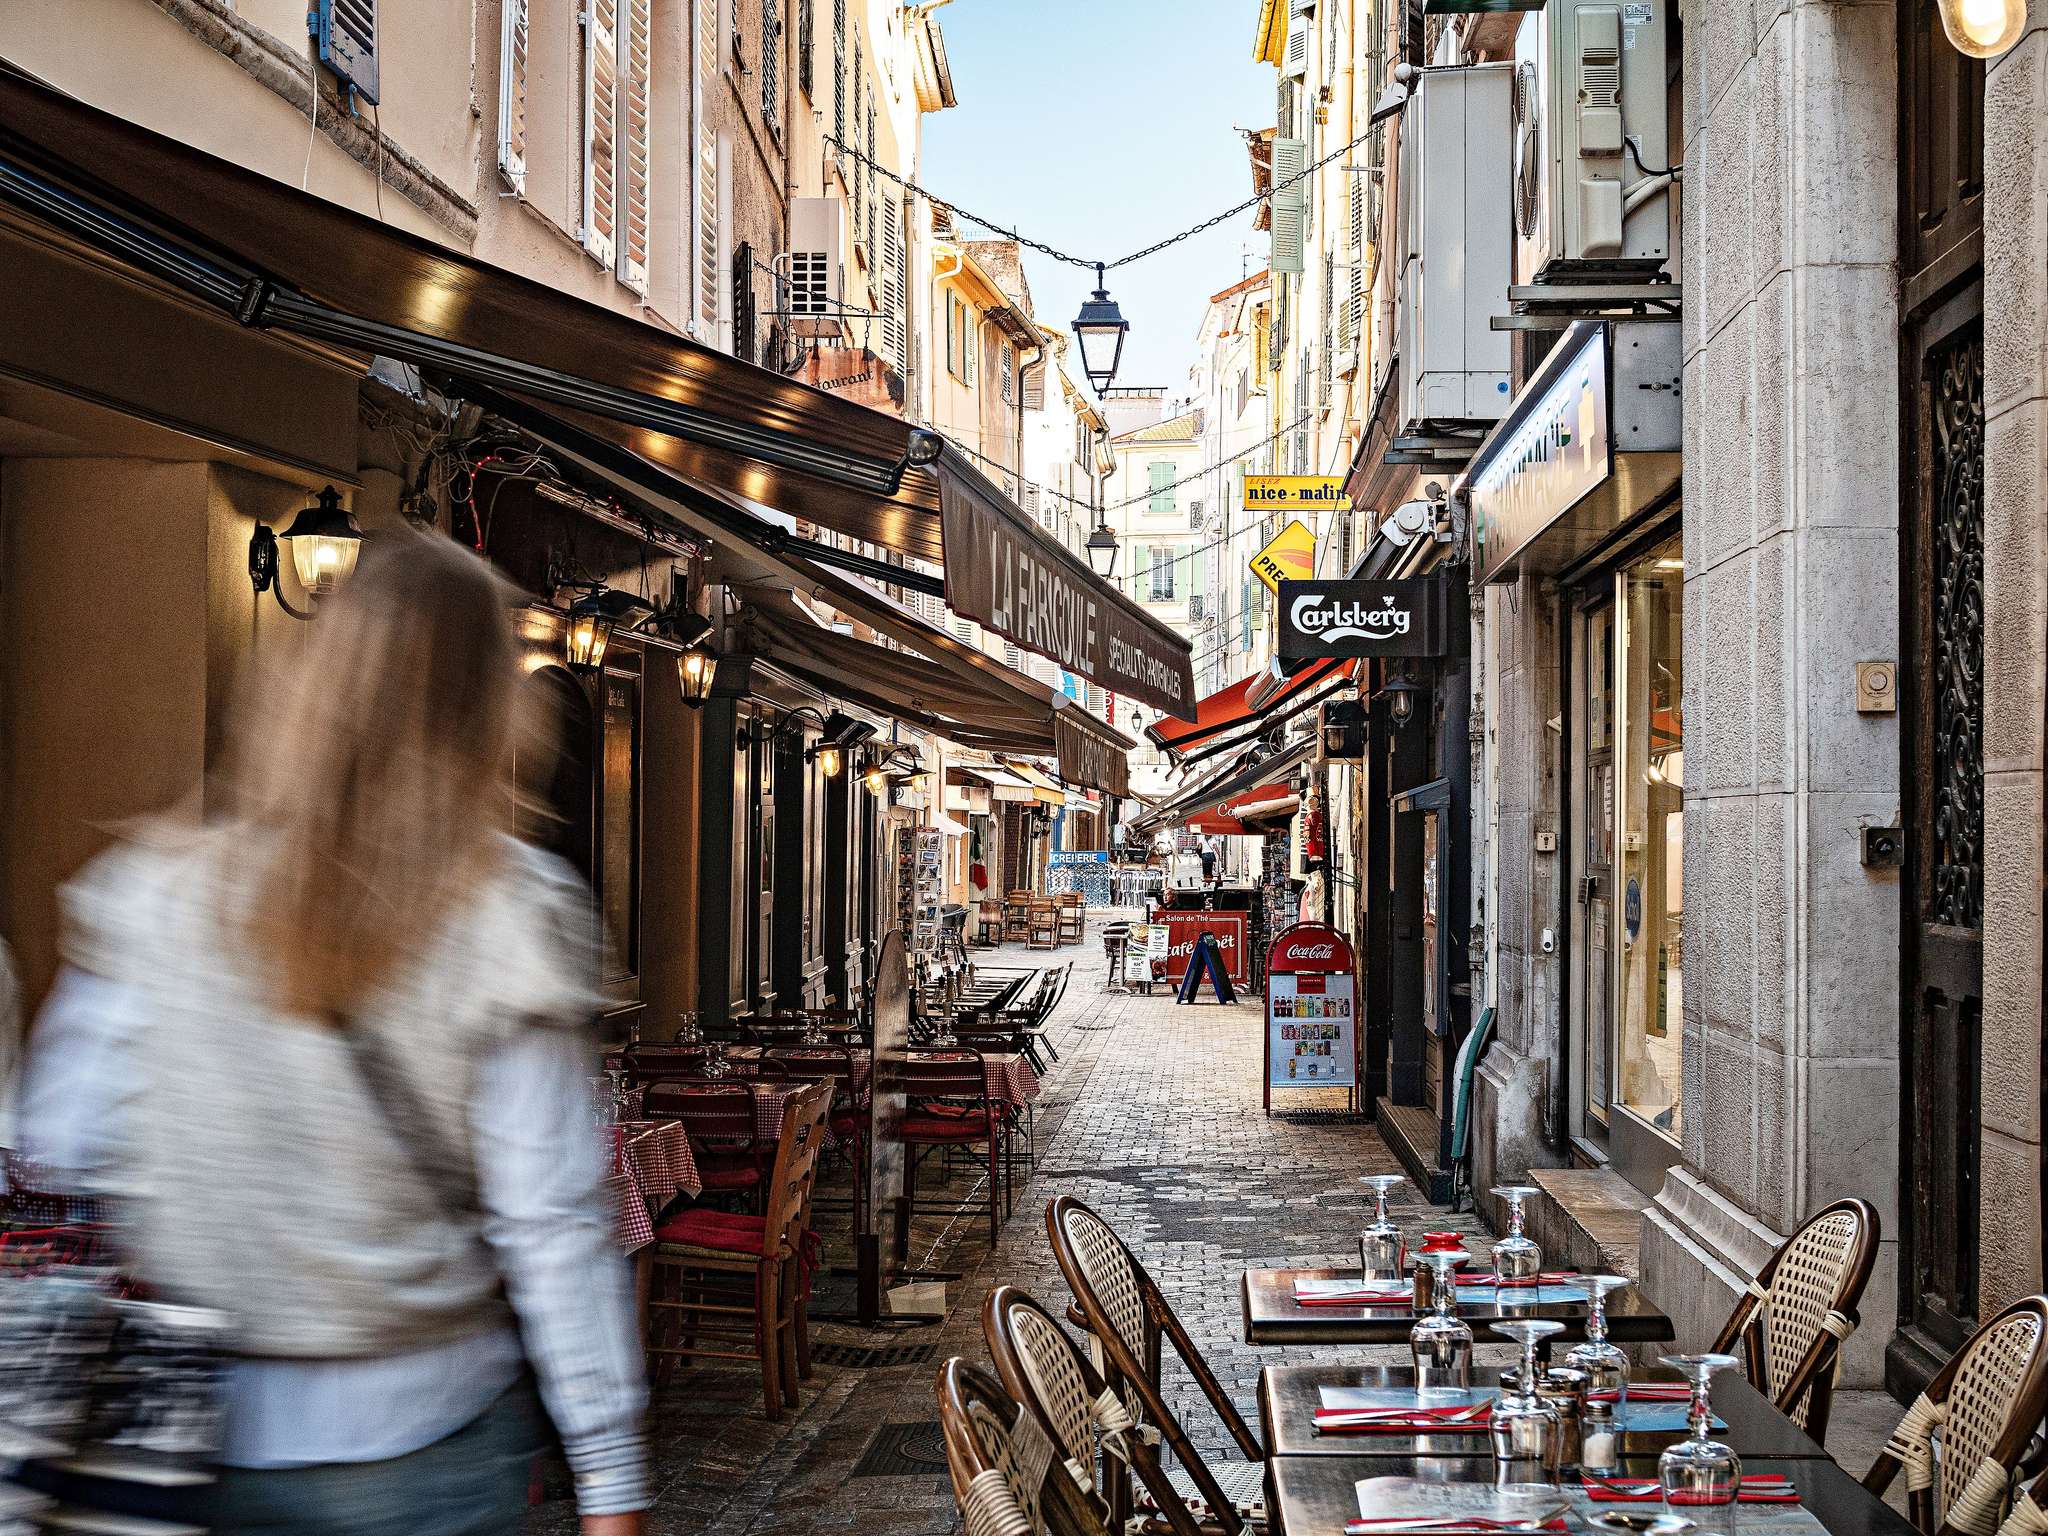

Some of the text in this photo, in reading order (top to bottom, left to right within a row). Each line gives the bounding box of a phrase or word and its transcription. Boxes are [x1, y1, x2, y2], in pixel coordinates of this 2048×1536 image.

[1248, 485, 1288, 500] nice
[1299, 483, 1346, 500] matin
[1257, 556, 1290, 583] PRE
[992, 530, 1013, 635] LA
[1018, 551, 1096, 676] FARIGOULE
[1290, 594, 1411, 635] Carlsberg
[1196, 914, 1209, 922] Thé
[1286, 944, 1335, 959] Coca-Cola
